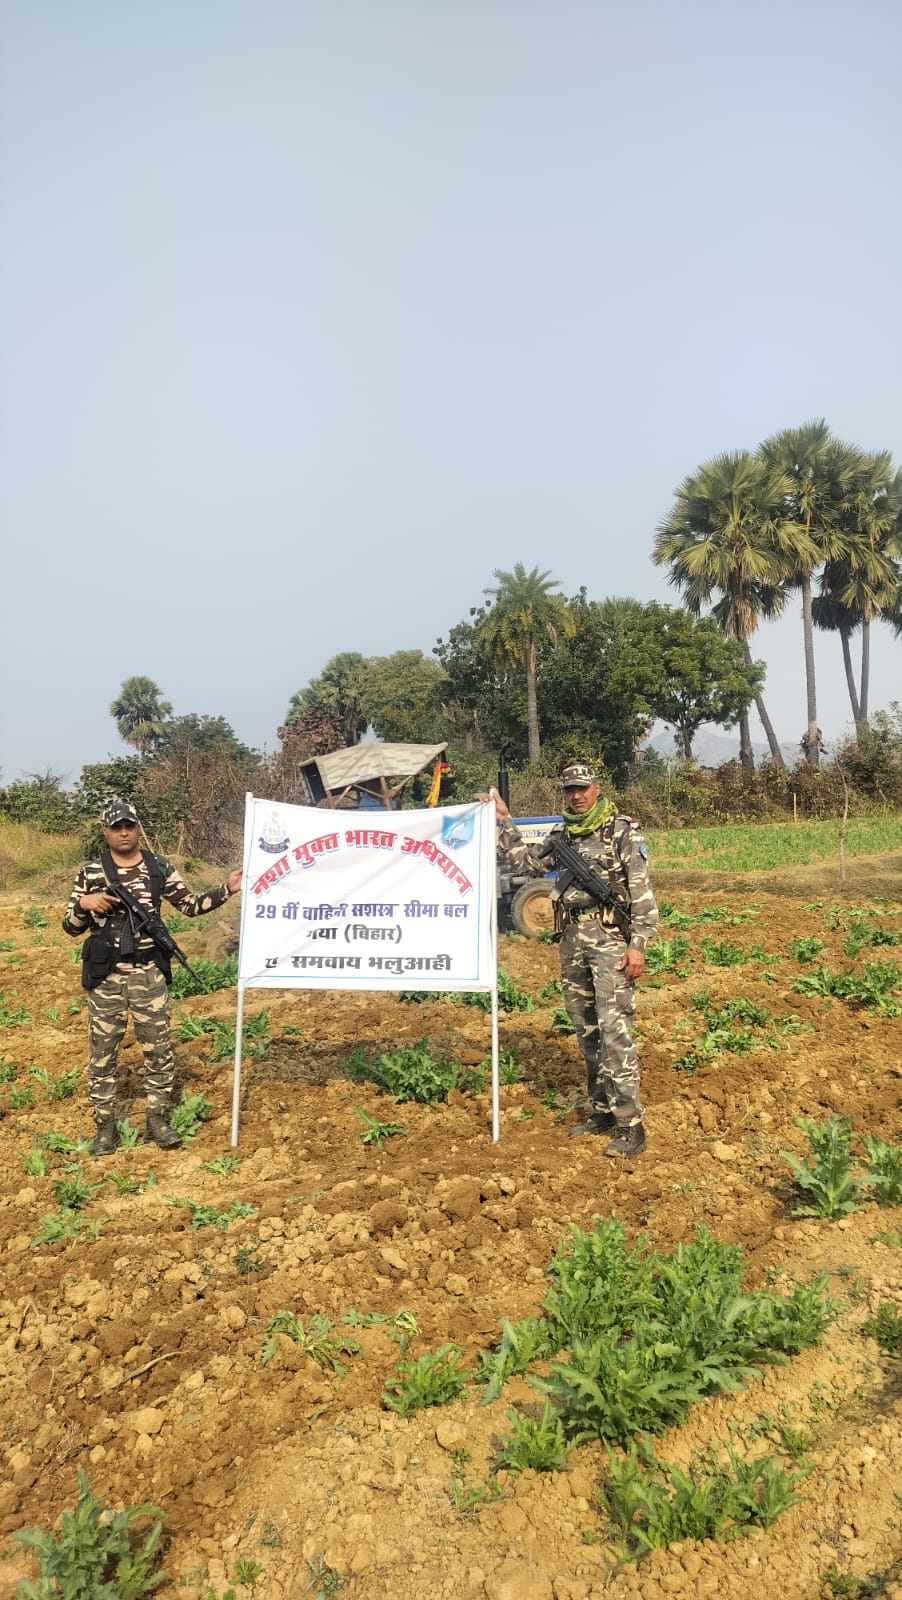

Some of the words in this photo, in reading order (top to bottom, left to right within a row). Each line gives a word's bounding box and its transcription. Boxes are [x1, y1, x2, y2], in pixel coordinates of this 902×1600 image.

[251, 855, 290, 896] नशा
[293, 831, 339, 866] मुक्त
[345, 829, 397, 848] भारत
[400, 835, 473, 895] अभियान
[255, 904, 277, 919] 29
[282, 901, 300, 920] वीं
[403, 900, 439, 918] सीमा
[443, 903, 469, 918] बल
[344, 924, 402, 944] (बिहार)
[291, 955, 361, 970] समवाय
[368, 953, 453, 975] भलुआही
